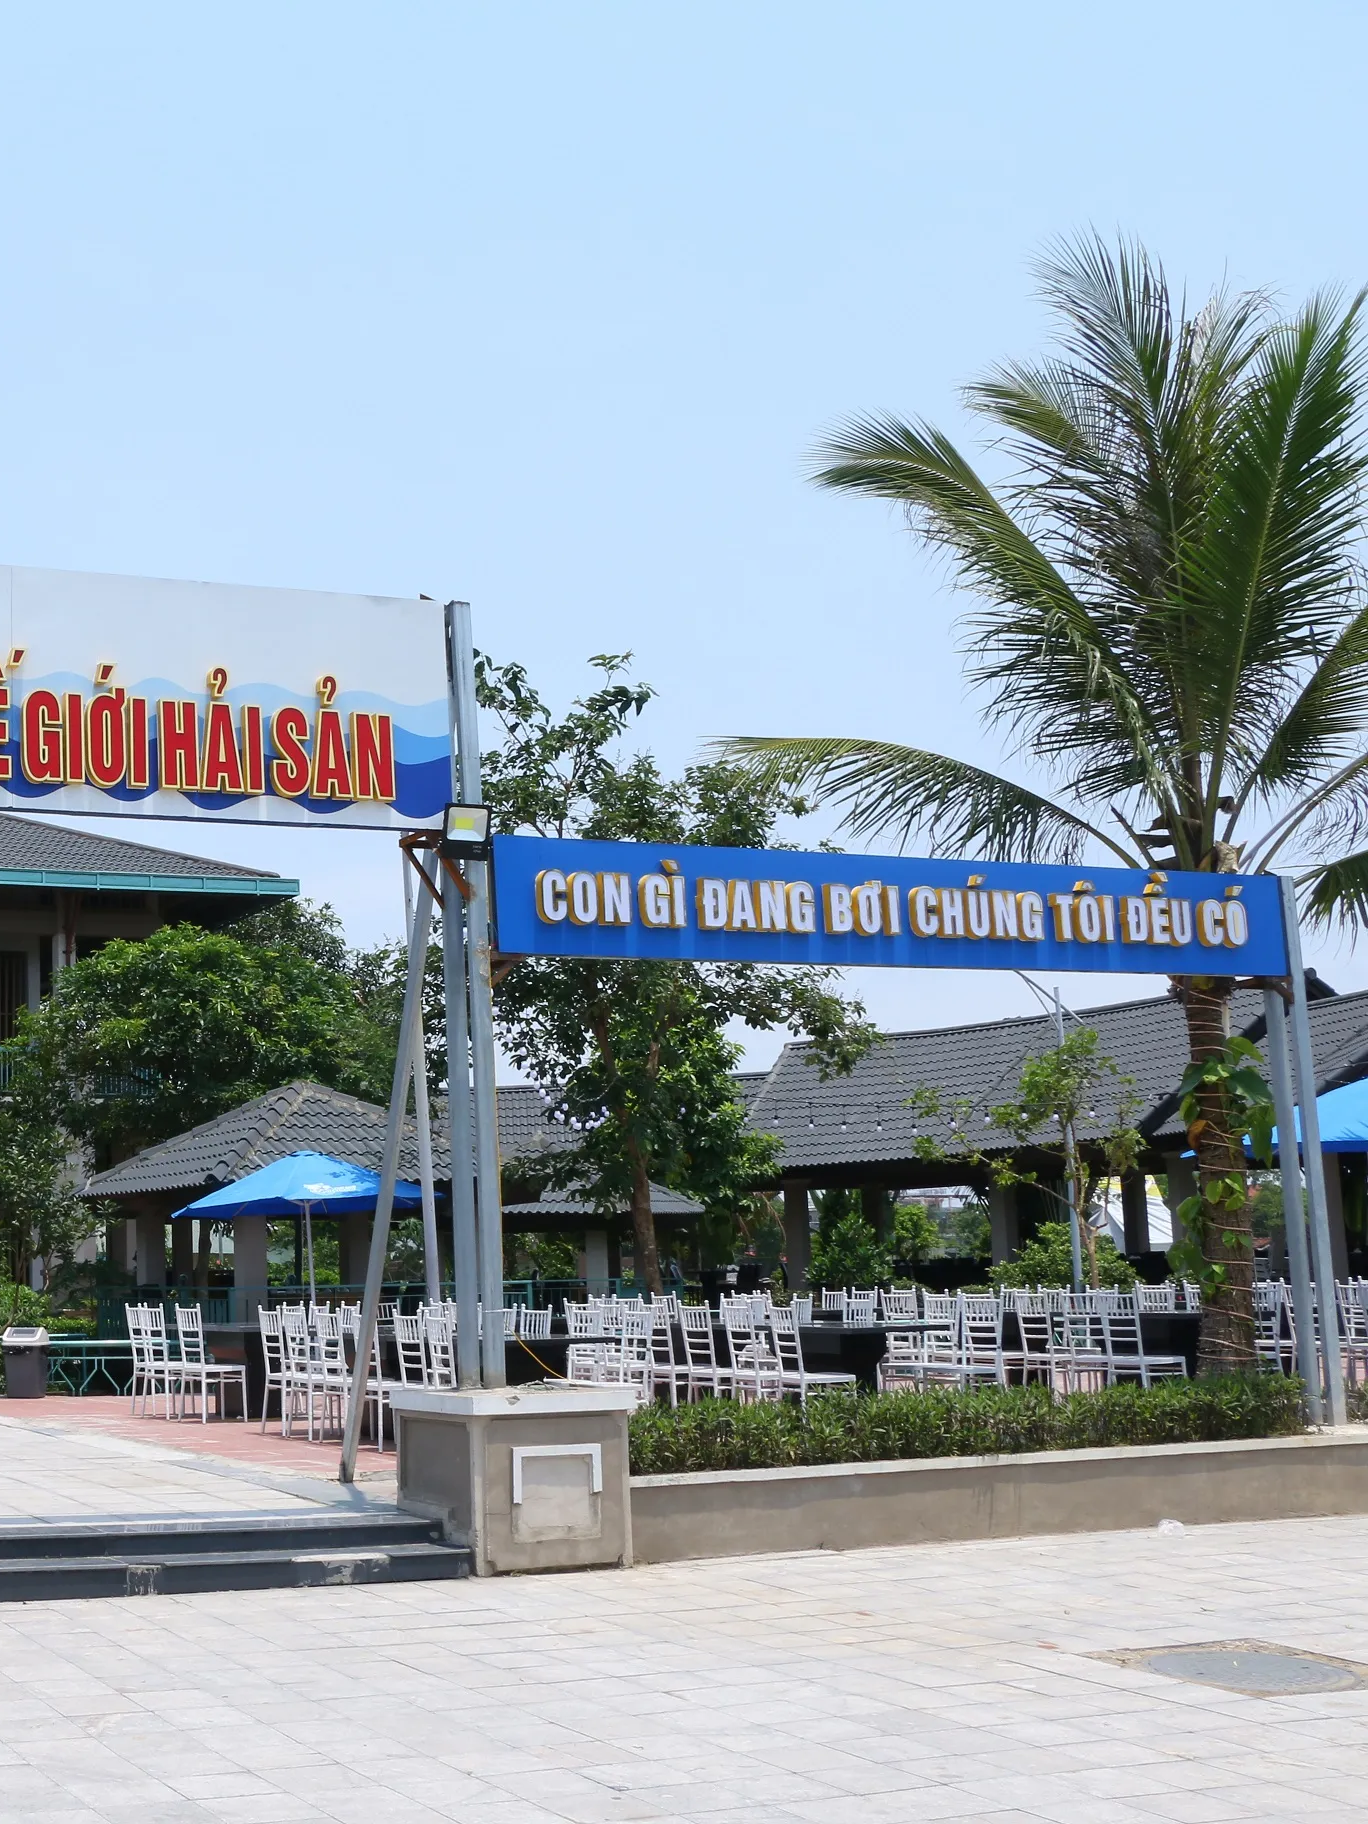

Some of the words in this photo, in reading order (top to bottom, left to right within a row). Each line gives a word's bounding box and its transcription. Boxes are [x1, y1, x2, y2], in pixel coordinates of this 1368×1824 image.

[21, 663, 150, 790] GIỚI
[157, 666, 265, 795] HẢI
[271, 675, 396, 801] SẢN
[535, 868, 632, 926] CON
[638, 859, 687, 929] GÌ
[695, 877, 816, 933] ĐANG
[821, 880, 902, 937] BƠI
[908, 874, 1045, 942] CHÚNG
[1047, 879, 1116, 943] TÔI
[1118, 871, 1192, 947] ĐỀU
[1195, 885, 1249, 948] CÓ
